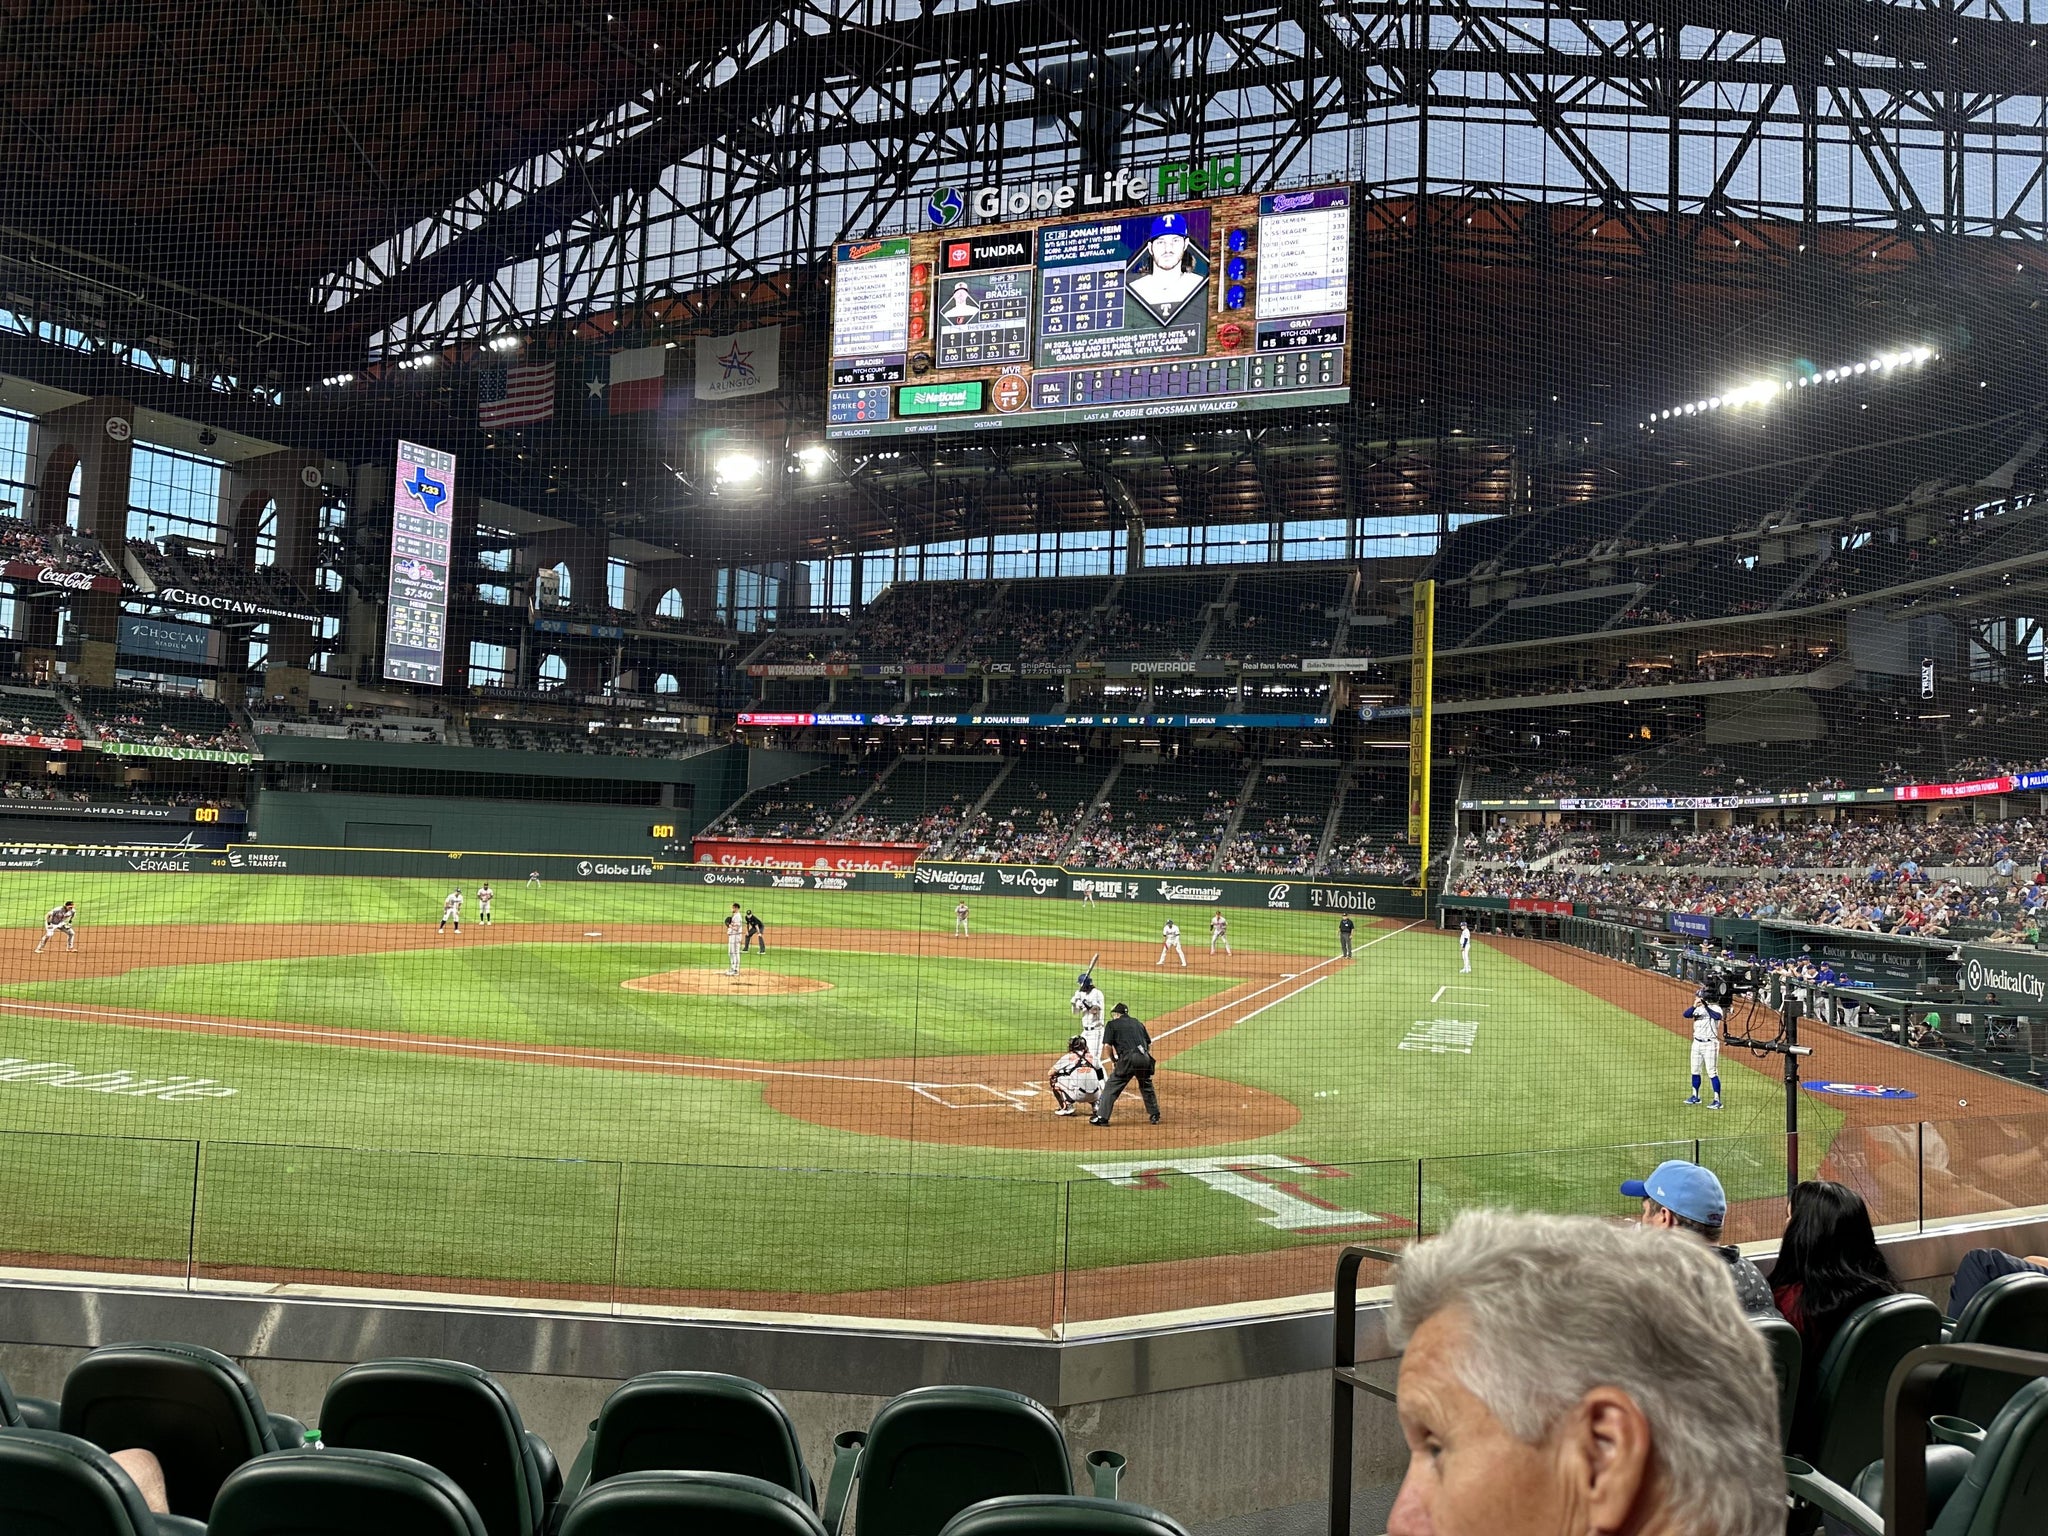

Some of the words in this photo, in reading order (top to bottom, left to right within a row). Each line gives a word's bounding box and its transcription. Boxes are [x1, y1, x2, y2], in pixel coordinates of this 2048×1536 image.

[973, 181, 1075, 218] Globe
[1083, 168, 1148, 206] Life
[1157, 154, 1241, 197] Field
[1272, 192, 1315, 212] Rangers
[1068, 226, 1098, 239] JONAH
[1099, 225, 1122, 237] HEIM
[974, 243, 1025, 259] TUNDRA
[1280, 271, 1317, 279] GROSSMAN
[985, 289, 1022, 299] BRADISH
[1290, 320, 1312, 328] GRAY
[1300, 328, 1321, 336] COUNT
[1324, 333, 1337, 342] 24
[1072, 339, 1087, 347] HAD
[1139, 333, 1157, 341] WITH
[1161, 336, 1188, 345] CAREER
[1269, 339, 1276, 347] 5
[1296, 336, 1307, 344] 19
[1056, 353, 1081, 362] GRAND
[1082, 352, 1100, 360] SLAM
[1101, 350, 1113, 358] ON
[1114, 348, 1134, 357] APRIL
[855, 358, 884, 366] BRADISH
[888, 371, 899, 380] 25
[1002, 366, 1021, 374] MVR
[709, 376, 761, 391] ARLINGTON
[1043, 383, 1060, 392] BAL
[925, 390, 967, 402] National
[1042, 395, 1060, 403] TEX
[832, 402, 857, 410] STRIKE
[1112, 408, 1143, 419] ROBBIE
[1146, 404, 1197, 416] GROSSMAN
[1199, 402, 1238, 412] WALKED
[832, 413, 847, 421] OUT
[108, 422, 127, 437] 29
[844, 428, 870, 436] VELOCITY
[918, 424, 937, 432] ANGLE
[305, 470, 317, 483] 10
[38, 567, 96, 590] Coca-Cola
[404, 587, 433, 599] $7,540
[172, 589, 257, 614] CHOCTAW
[257, 607, 286, 617] CASINOS
[293, 613, 321, 622] RESORTS
[140, 626, 205, 644] CHOCTAW
[768, 665, 826, 675] WHATABURGER
[880, 666, 903, 674] 105.3
[991, 664, 1015, 672] PGL
[1131, 662, 1196, 672] POWERADE
[1243, 662, 1259, 670] Real
[1922, 666, 1930, 693] TRULY
[484, 688, 528, 698] PRIORITY
[531, 692, 558, 700] GOLD
[585, 695, 613, 706] HART
[616, 698, 646, 708] HVAC
[669, 702, 718, 714] PLUCKERS
[0, 733, 29, 743] DEX
[38, 736, 67, 745] DEX
[120, 743, 173, 758] LUXOR
[178, 748, 249, 763] STAFFING
[84, 807, 169, 816] AHEAD-READY
[195, 808, 218, 822] 0:07
[652, 825, 674, 838] 0:07
[248, 860, 287, 868] TRANSFER
[594, 863, 629, 876] Globe
[631, 865, 652, 876] Life
[716, 874, 745, 884] Kubota
[1016, 869, 1058, 894] Kroger
[1096, 881, 1123, 893] BITE
[1175, 885, 1222, 896] Germania
[1325, 889, 1377, 911] Mobile
[1983, 967, 2021, 992] Medical
[2022, 973, 2046, 1003] City
[1076, 1154, 1395, 1232] T
